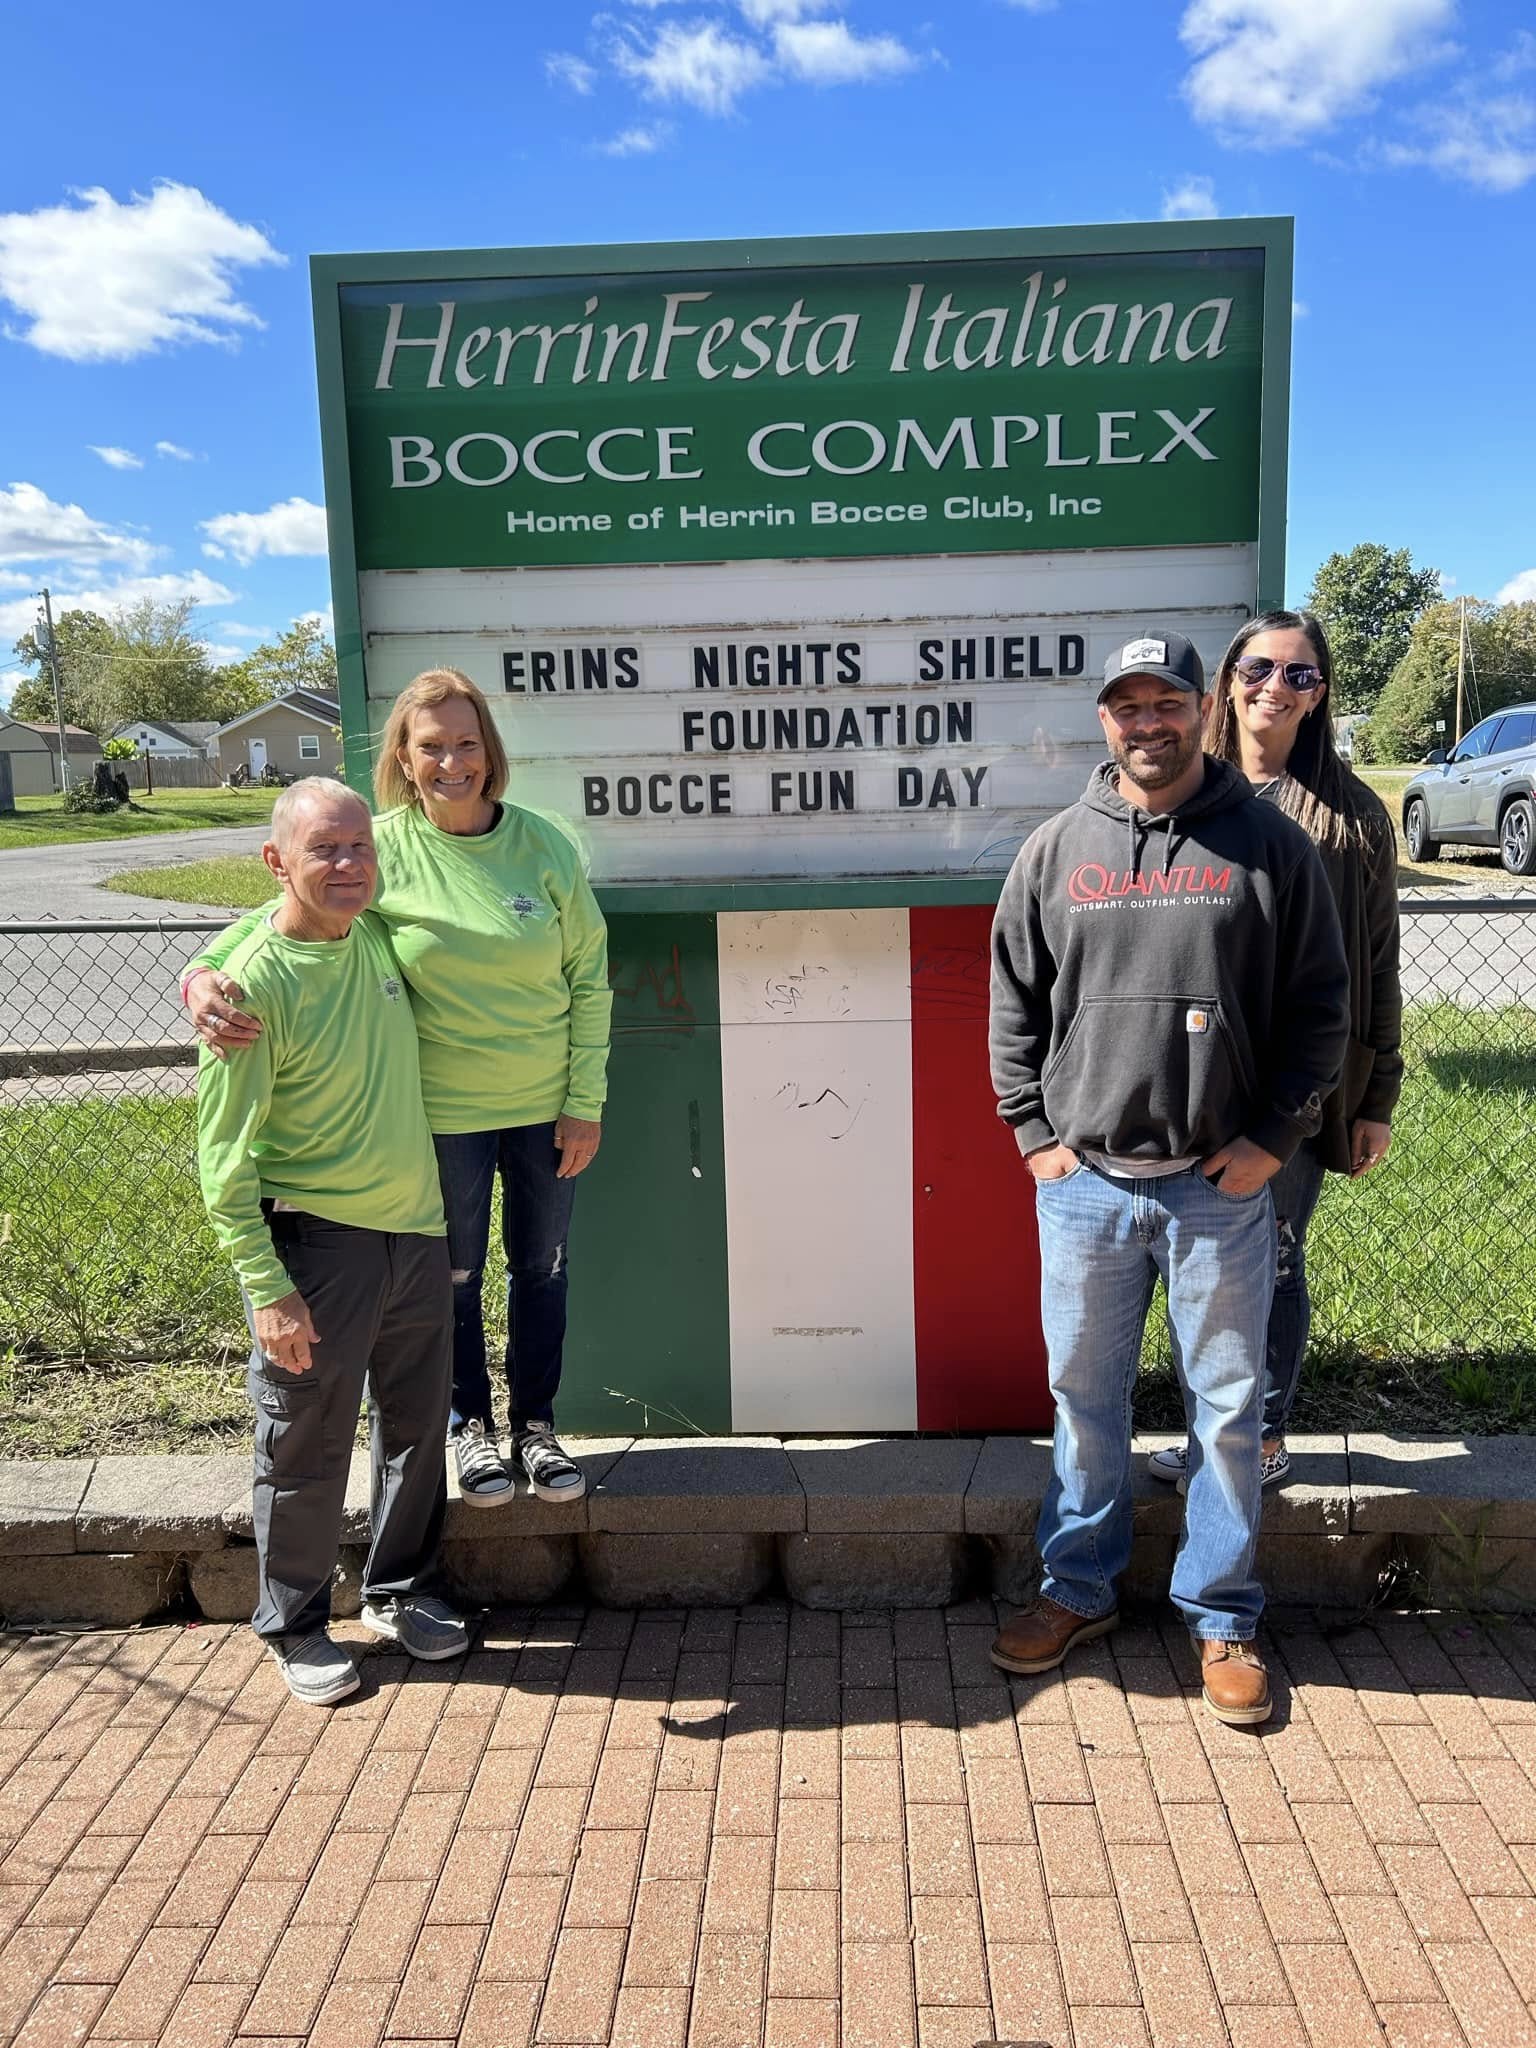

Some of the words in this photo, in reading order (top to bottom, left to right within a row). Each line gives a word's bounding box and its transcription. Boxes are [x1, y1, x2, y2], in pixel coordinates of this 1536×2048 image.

[375, 291, 860, 390] HerrinFesta
[889, 271, 1235, 374] Italiana
[390, 426, 704, 490] BOCCE
[747, 407, 1221, 480] COMPLEX
[507, 507, 612, 535] Home
[628, 505, 664, 531] of
[680, 503, 795, 529] Herrin
[810, 500, 928, 525] Bocce
[944, 494, 1034, 523] Club,
[1049, 492, 1103, 516] Inc
[503, 647, 640, 693] ERINS
[693, 642, 861, 689] NIGHTS
[919, 634, 1085, 681] SHIELD
[683, 701, 973, 753] FOUNDATION
[583, 773, 732, 817] BOCCE
[771, 770, 855, 812] FUN
[898, 765, 988, 808] DAY
[1069, 901, 1126, 914] OUTSMART.
[1130, 898, 1180, 909] OUTFISH.
